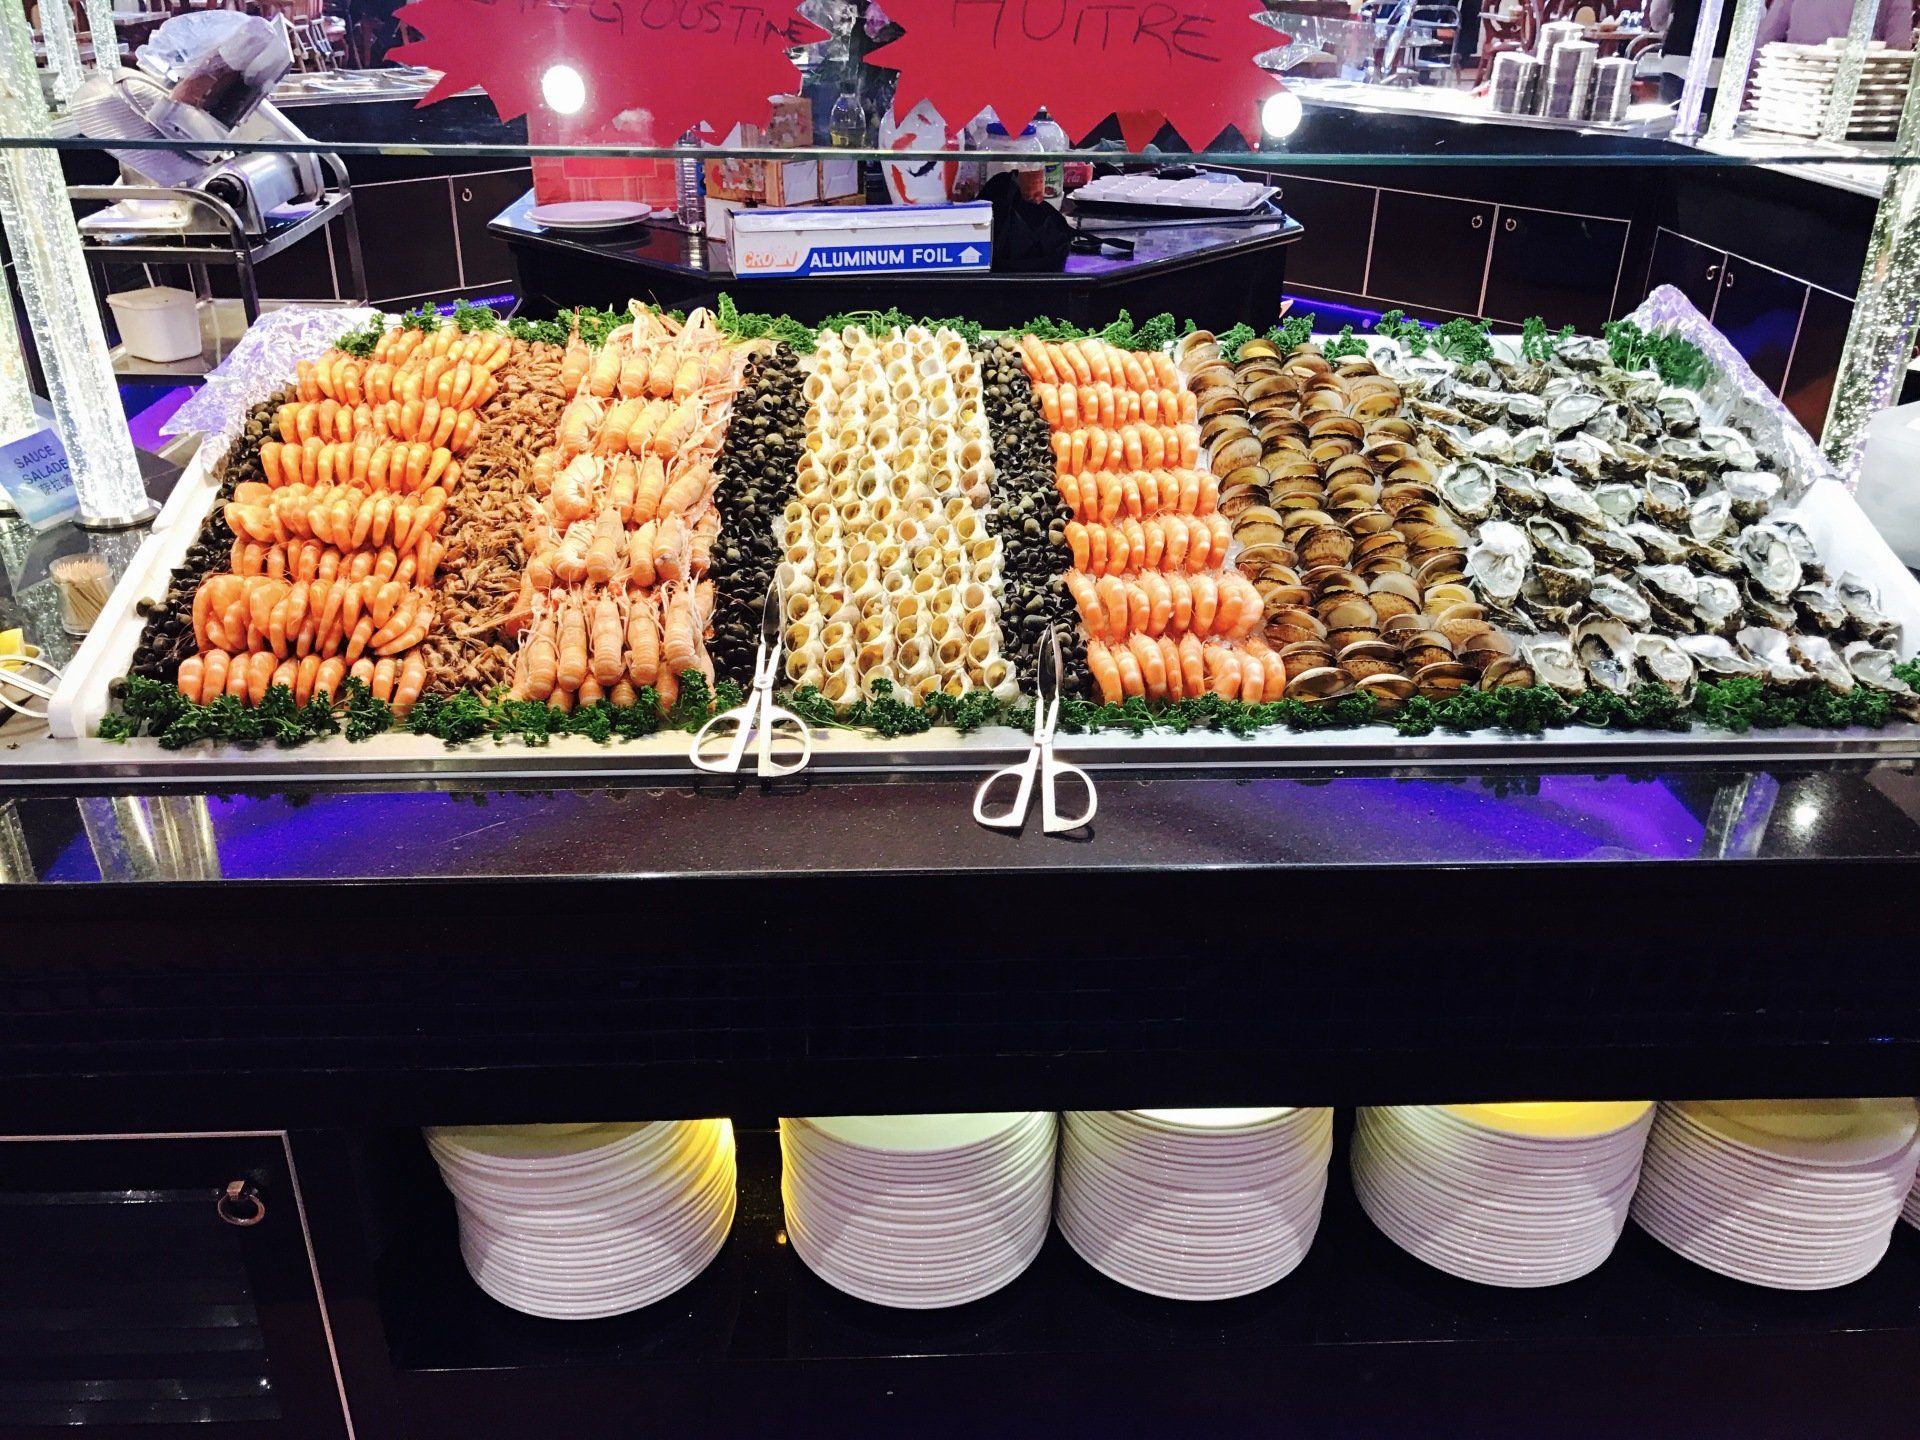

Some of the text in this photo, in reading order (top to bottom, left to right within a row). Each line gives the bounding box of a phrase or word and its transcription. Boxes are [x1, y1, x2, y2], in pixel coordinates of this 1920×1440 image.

[809, 247, 954, 268] ALUMINUM FOIL
[13, 445, 56, 469] SAUCE
[22, 459, 70, 485] SALADE
